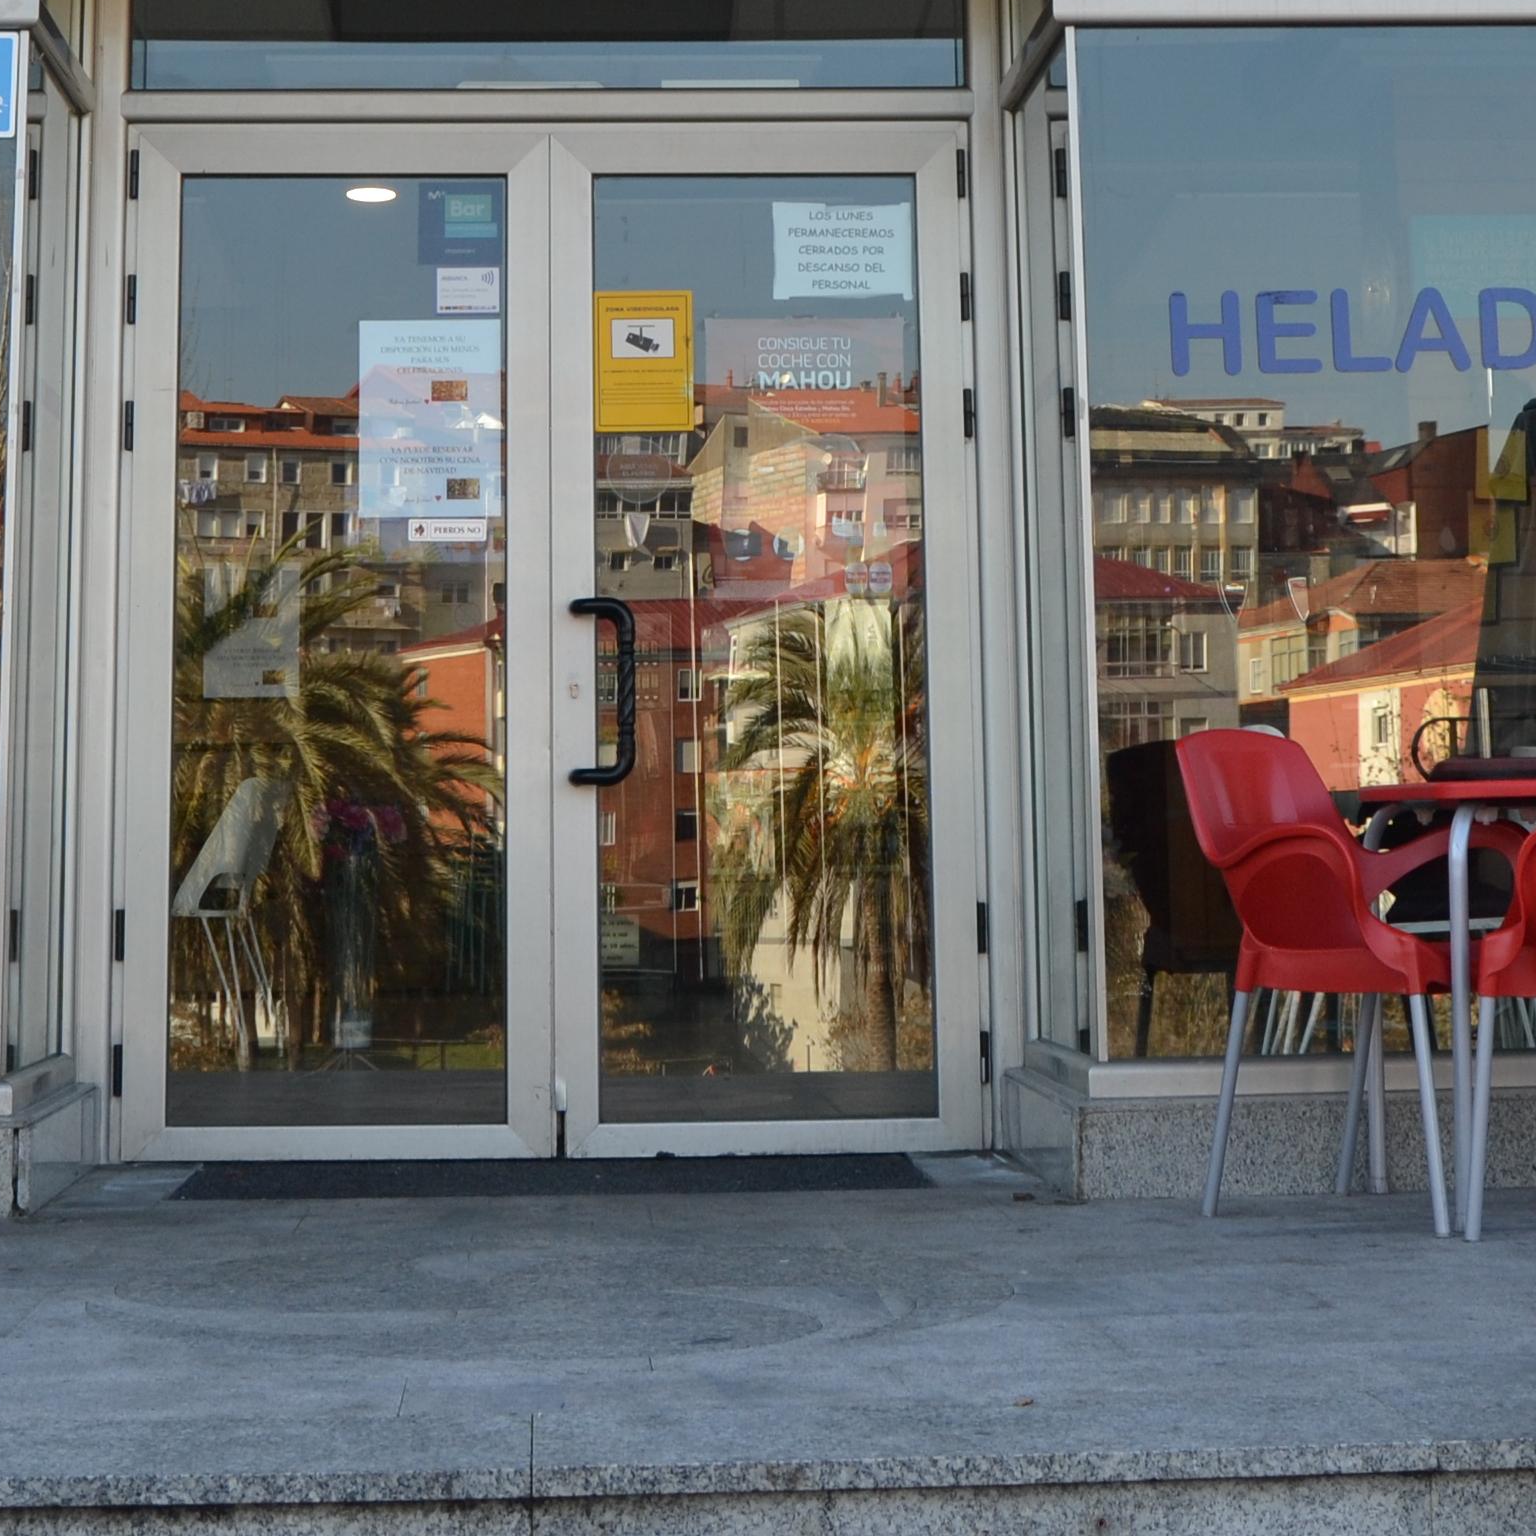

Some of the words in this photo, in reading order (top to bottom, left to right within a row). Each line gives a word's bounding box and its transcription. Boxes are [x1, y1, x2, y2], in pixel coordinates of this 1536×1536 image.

[809, 211, 831, 221] LOS
[836, 211, 873, 221] LUNES
[788, 227, 895, 238] PERMANECEREMOS
[798, 245, 858, 256] CERRADOS
[862, 246, 884, 256] POR
[798, 262, 860, 273] DESCANSO
[865, 263, 885, 273] DEL
[812, 279, 871, 290] PERSONAL
[757, 337, 829, 350] CONSIGUE
[832, 337, 851, 350] TU
[757, 354, 813, 368] COCHE
[816, 354, 851, 368] CON
[757, 370, 852, 390] MAHOU
[467, 526, 481, 534] NO
